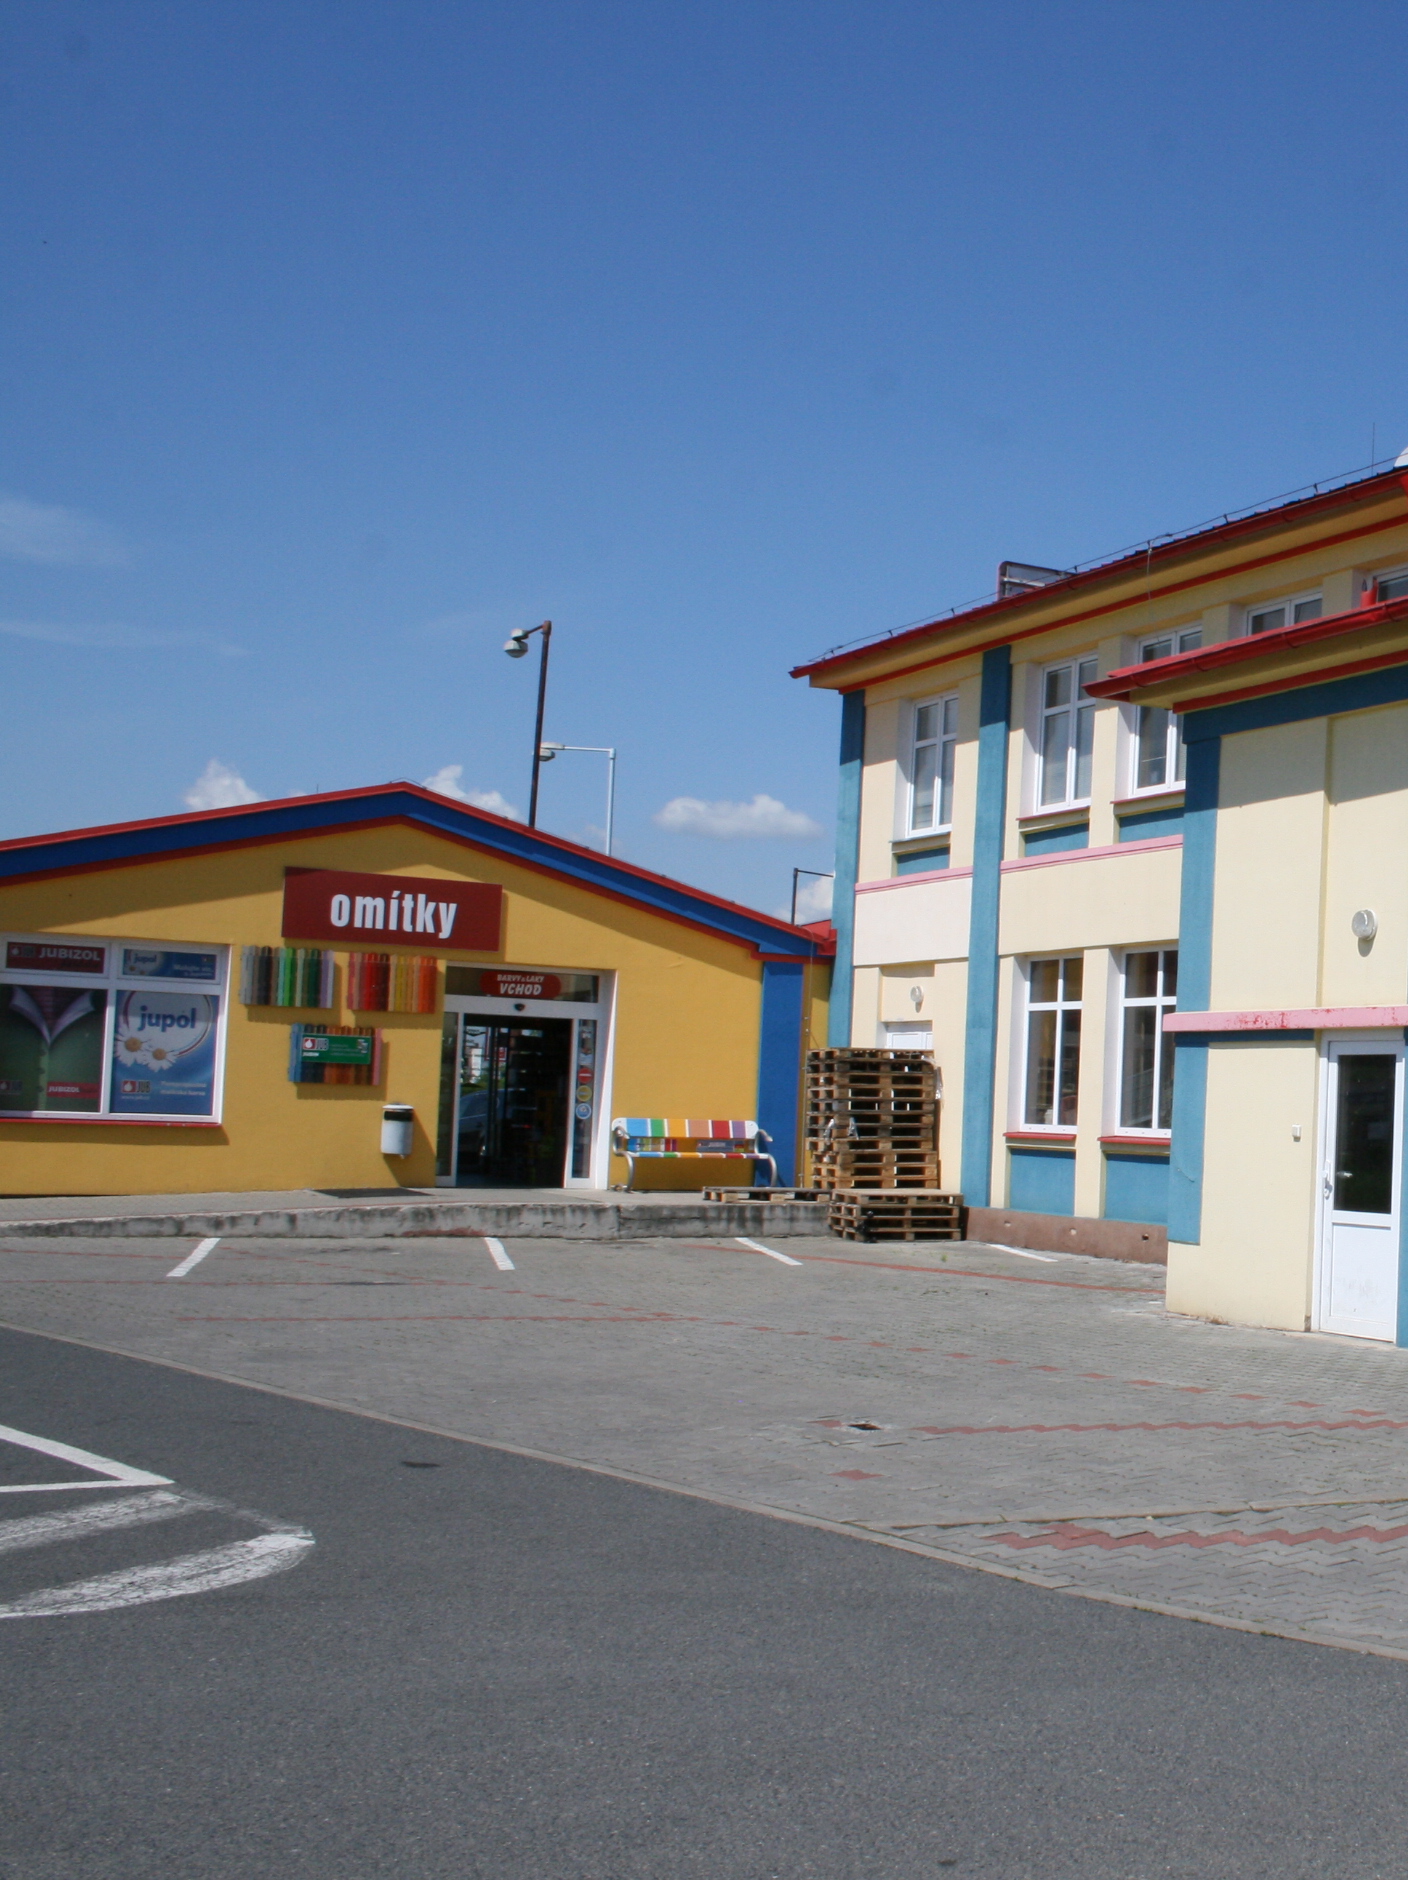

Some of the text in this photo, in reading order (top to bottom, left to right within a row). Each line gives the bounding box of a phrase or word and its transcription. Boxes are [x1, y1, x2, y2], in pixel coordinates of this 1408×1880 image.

[330, 890, 458, 939] omítky
[38, 947, 102, 961] JUBIZOL
[497, 974, 521, 982] BARVY
[500, 983, 543, 996] VCHOD
[138, 1005, 196, 1033] jupol
